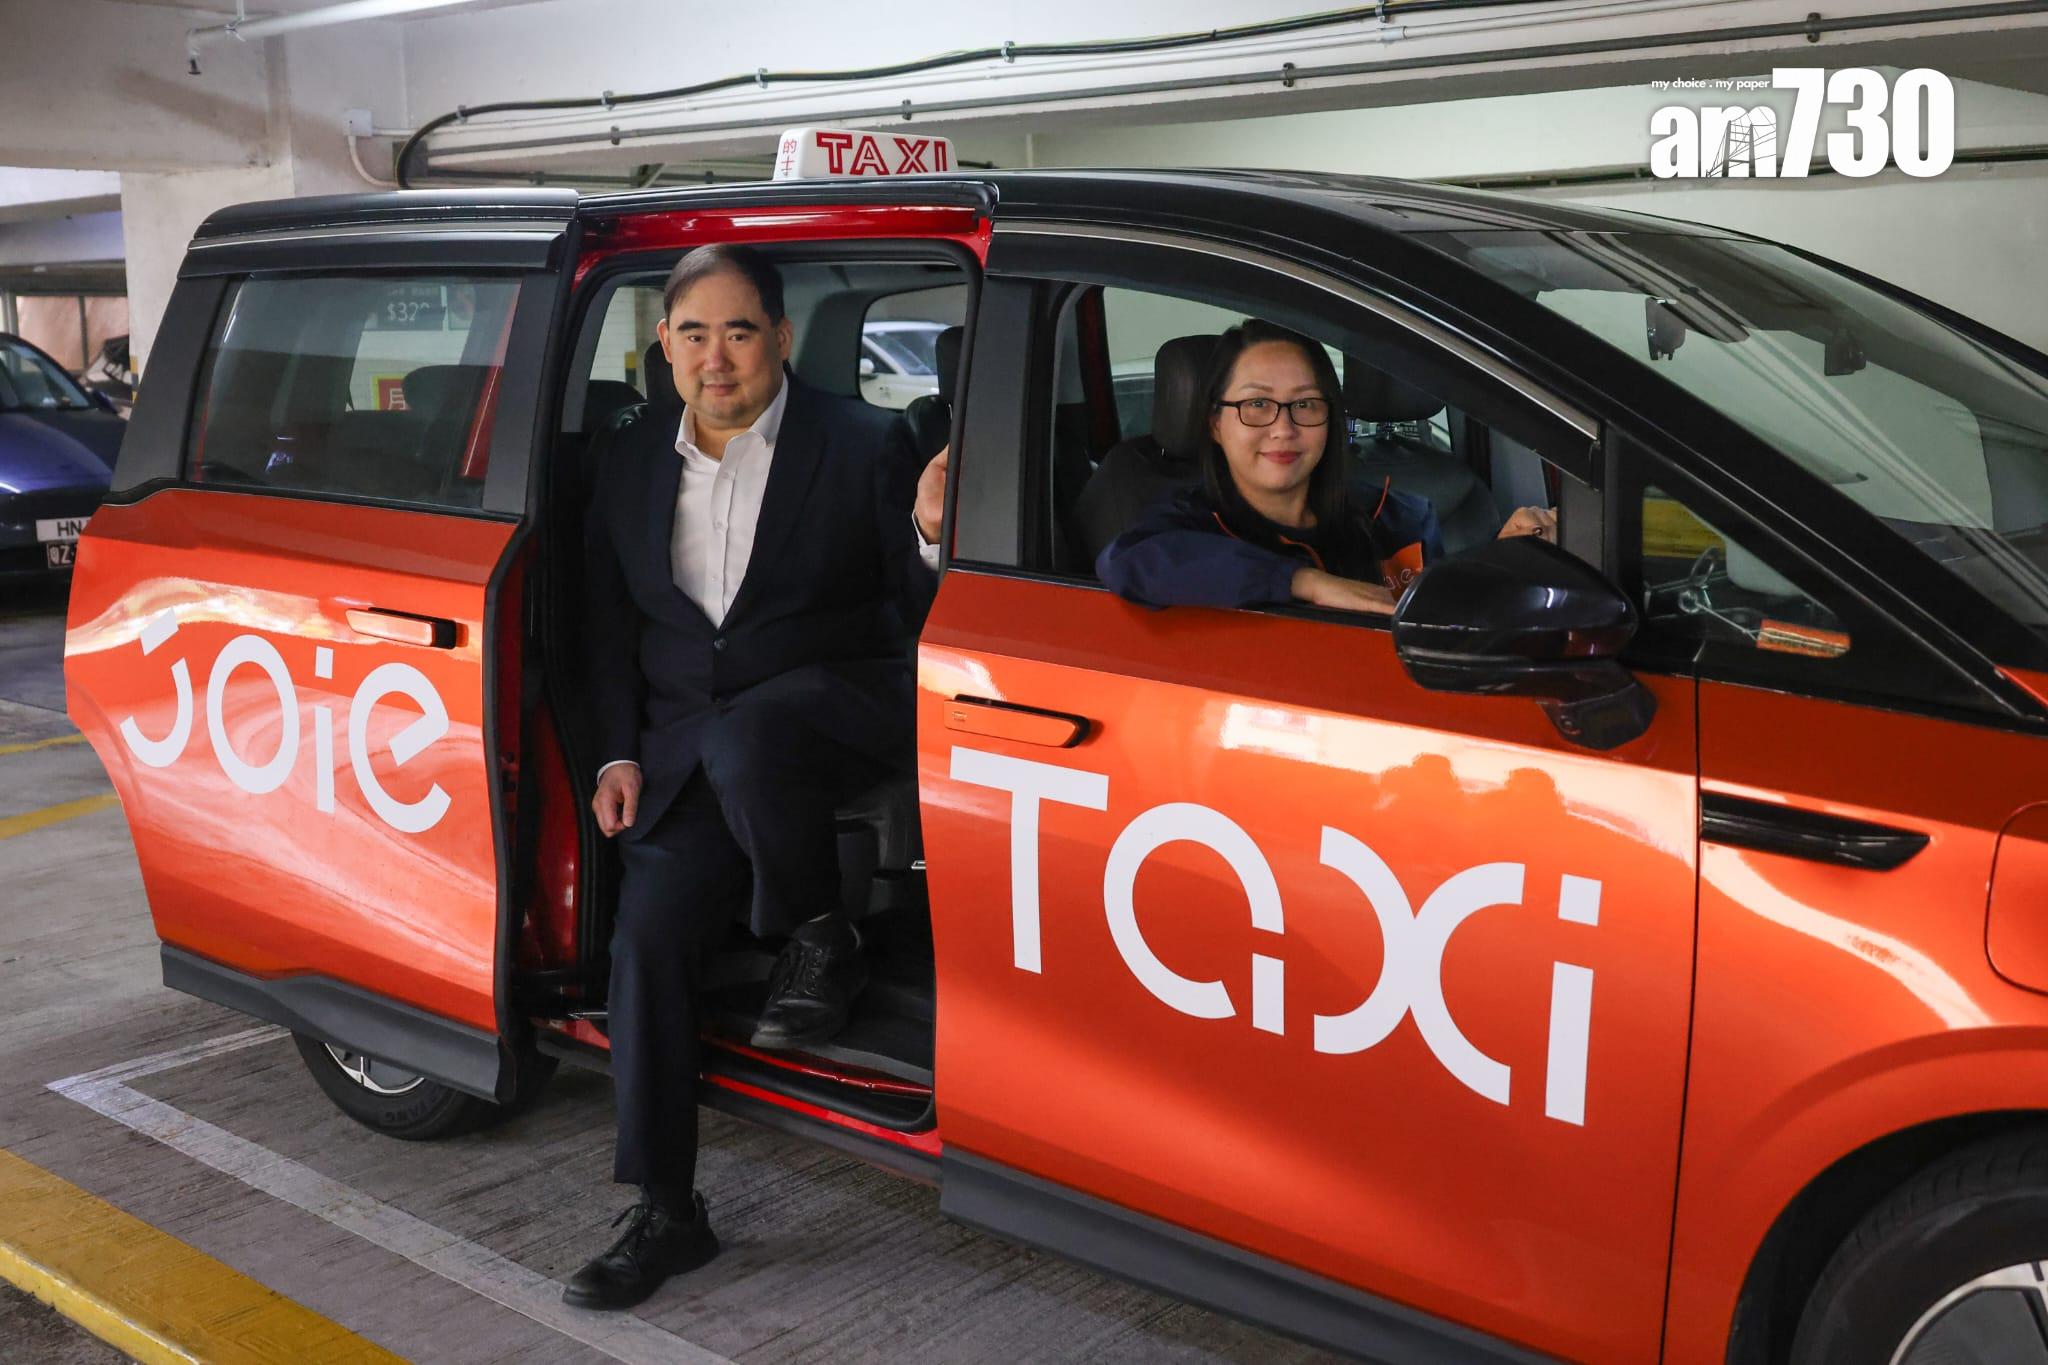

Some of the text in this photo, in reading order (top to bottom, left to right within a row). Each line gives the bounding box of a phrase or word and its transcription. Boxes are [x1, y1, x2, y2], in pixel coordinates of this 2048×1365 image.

[781, 138, 797, 172] 的士
[816, 132, 948, 175] TAXI
[950, 747, 1602, 1126] Taxi
